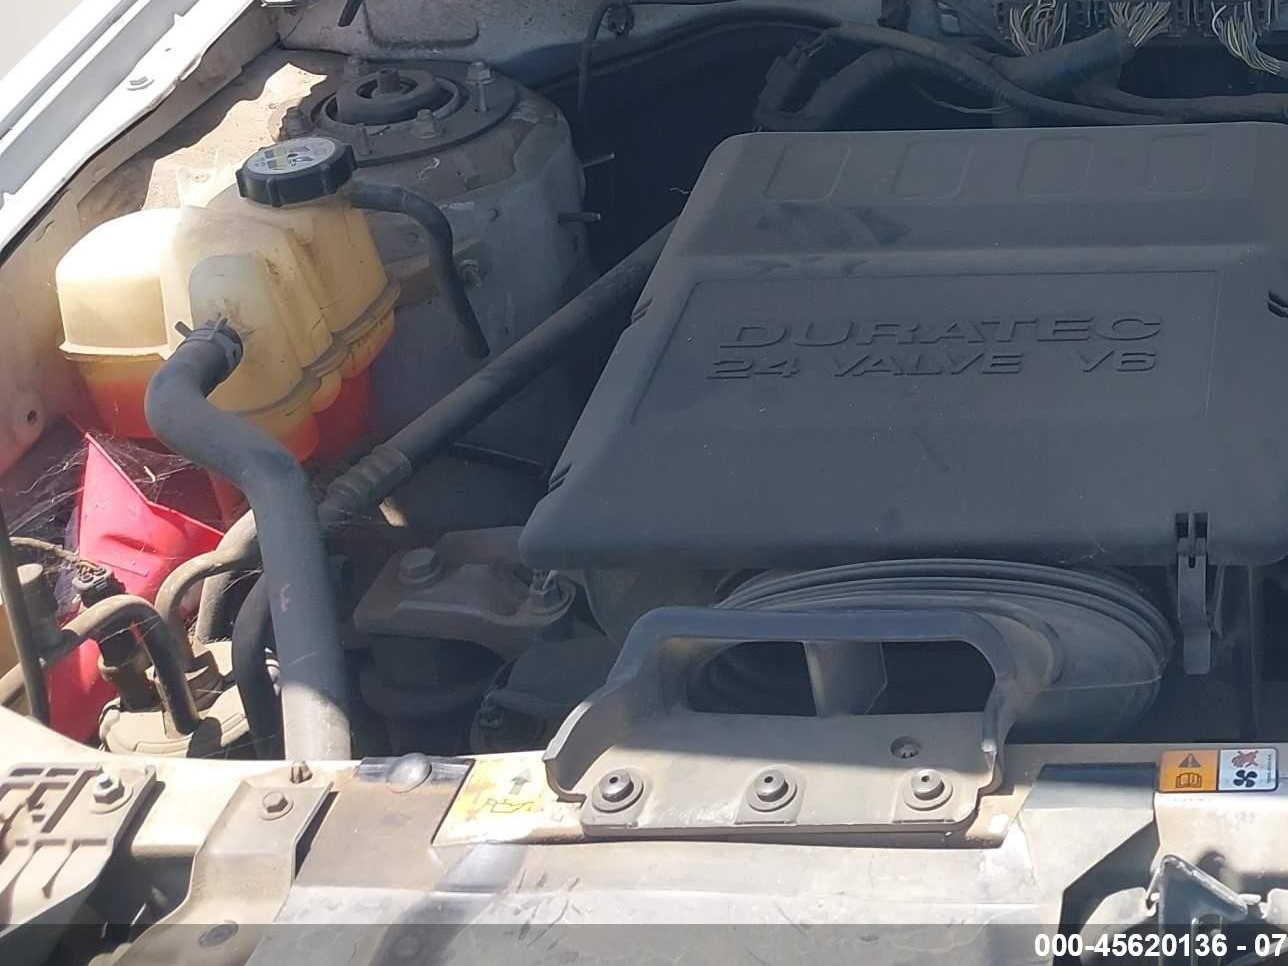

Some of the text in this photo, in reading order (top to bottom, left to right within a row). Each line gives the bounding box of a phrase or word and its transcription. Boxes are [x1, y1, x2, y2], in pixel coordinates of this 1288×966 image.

[719, 314, 1161, 348] DURATEC
[705, 350, 1157, 379] 24 VALVE V6
